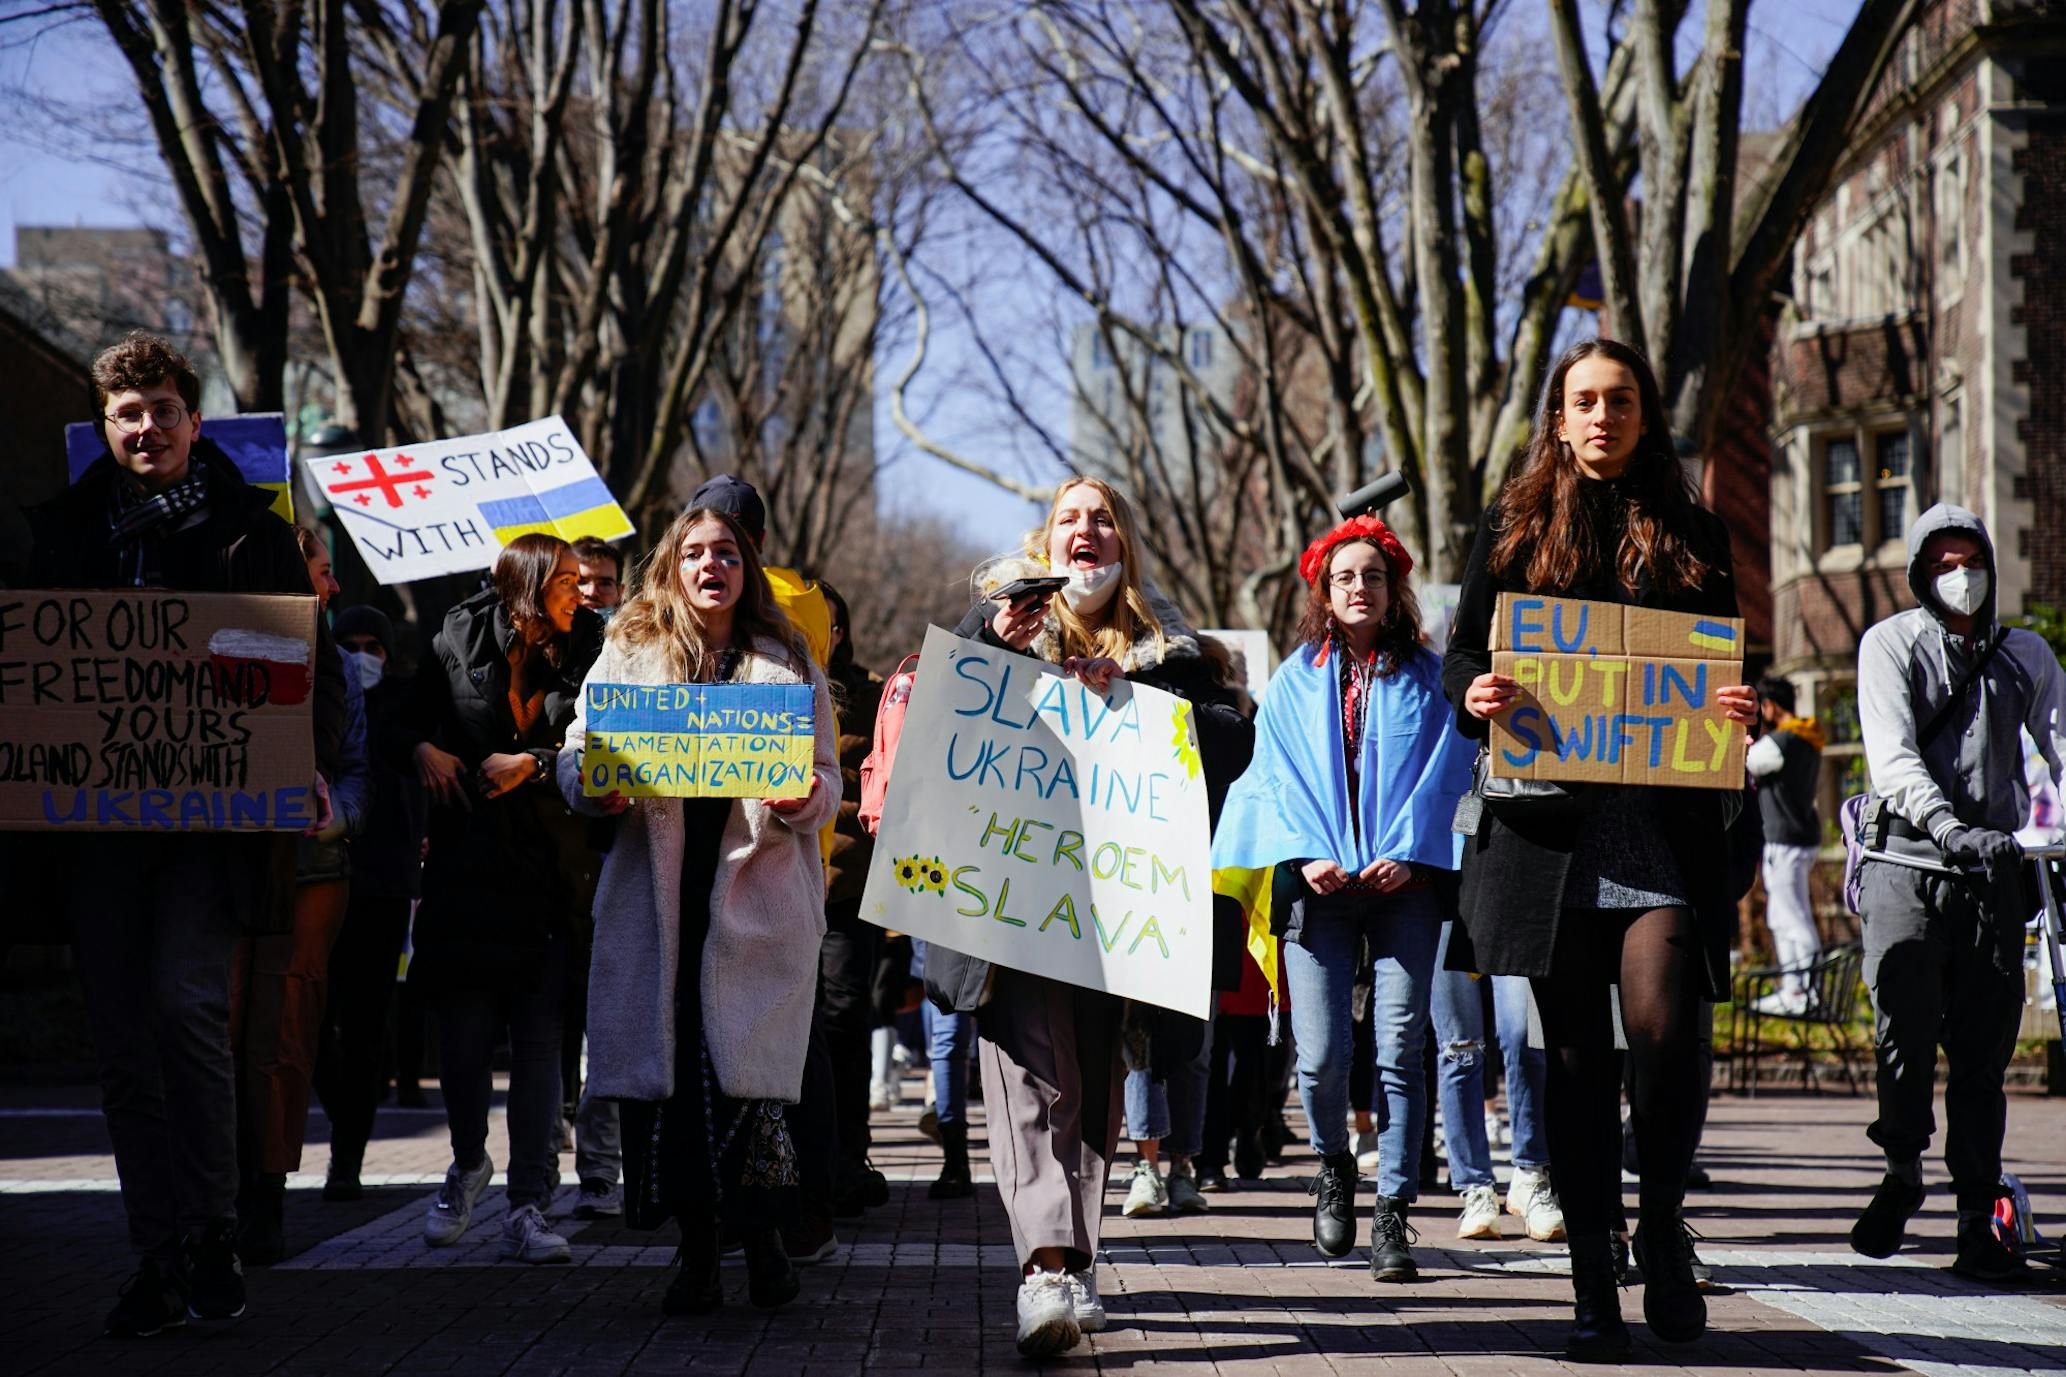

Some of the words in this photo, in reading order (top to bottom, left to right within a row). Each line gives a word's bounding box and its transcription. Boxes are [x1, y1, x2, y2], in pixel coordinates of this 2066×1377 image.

[441, 433, 574, 486] STANDS
[361, 518, 485, 561] WITH
[0, 598, 93, 652] FOR
[106, 599, 190, 651] OUR
[589, 687, 689, 711] UNITED
[98, 705, 252, 745] YOURS
[1502, 706, 1732, 772] SWIFTLY
[592, 760, 807, 788] ORGANIZATION
[42, 786, 312, 829] UKRAINE
